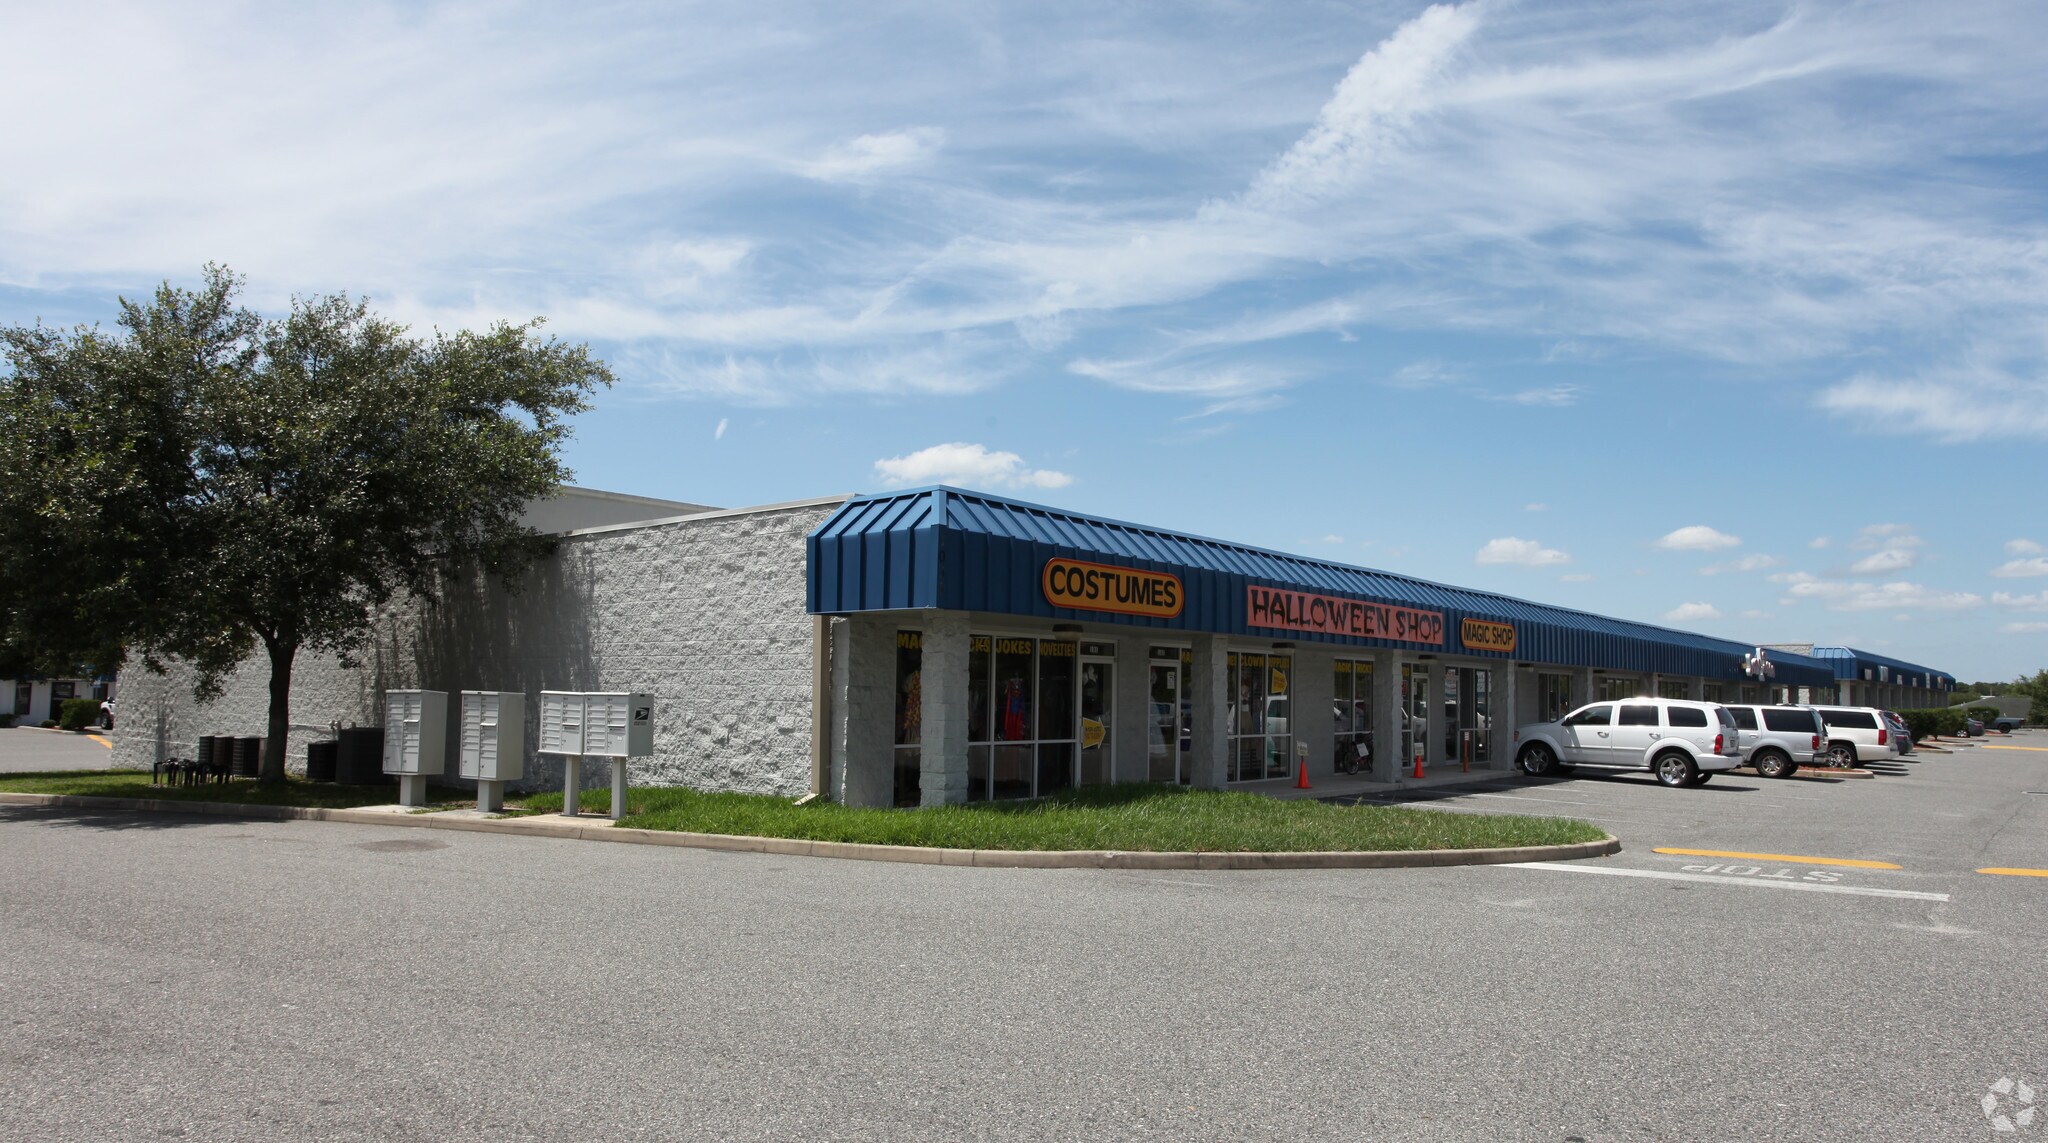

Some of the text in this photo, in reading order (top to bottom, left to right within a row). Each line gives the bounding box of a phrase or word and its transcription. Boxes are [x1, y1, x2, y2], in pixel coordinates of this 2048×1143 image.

[1050, 564, 1177, 608] COSTUMES
[1250, 588, 1442, 640] HALLOWEEN SHOP
[1463, 621, 1513, 646] MAGIC SHOP
[996, 639, 1032, 655] JOKES
[1040, 641, 1076, 656] NOVELTIES
[1241, 655, 1265, 667] CLOWN
[1681, 863, 1844, 882] STOP
